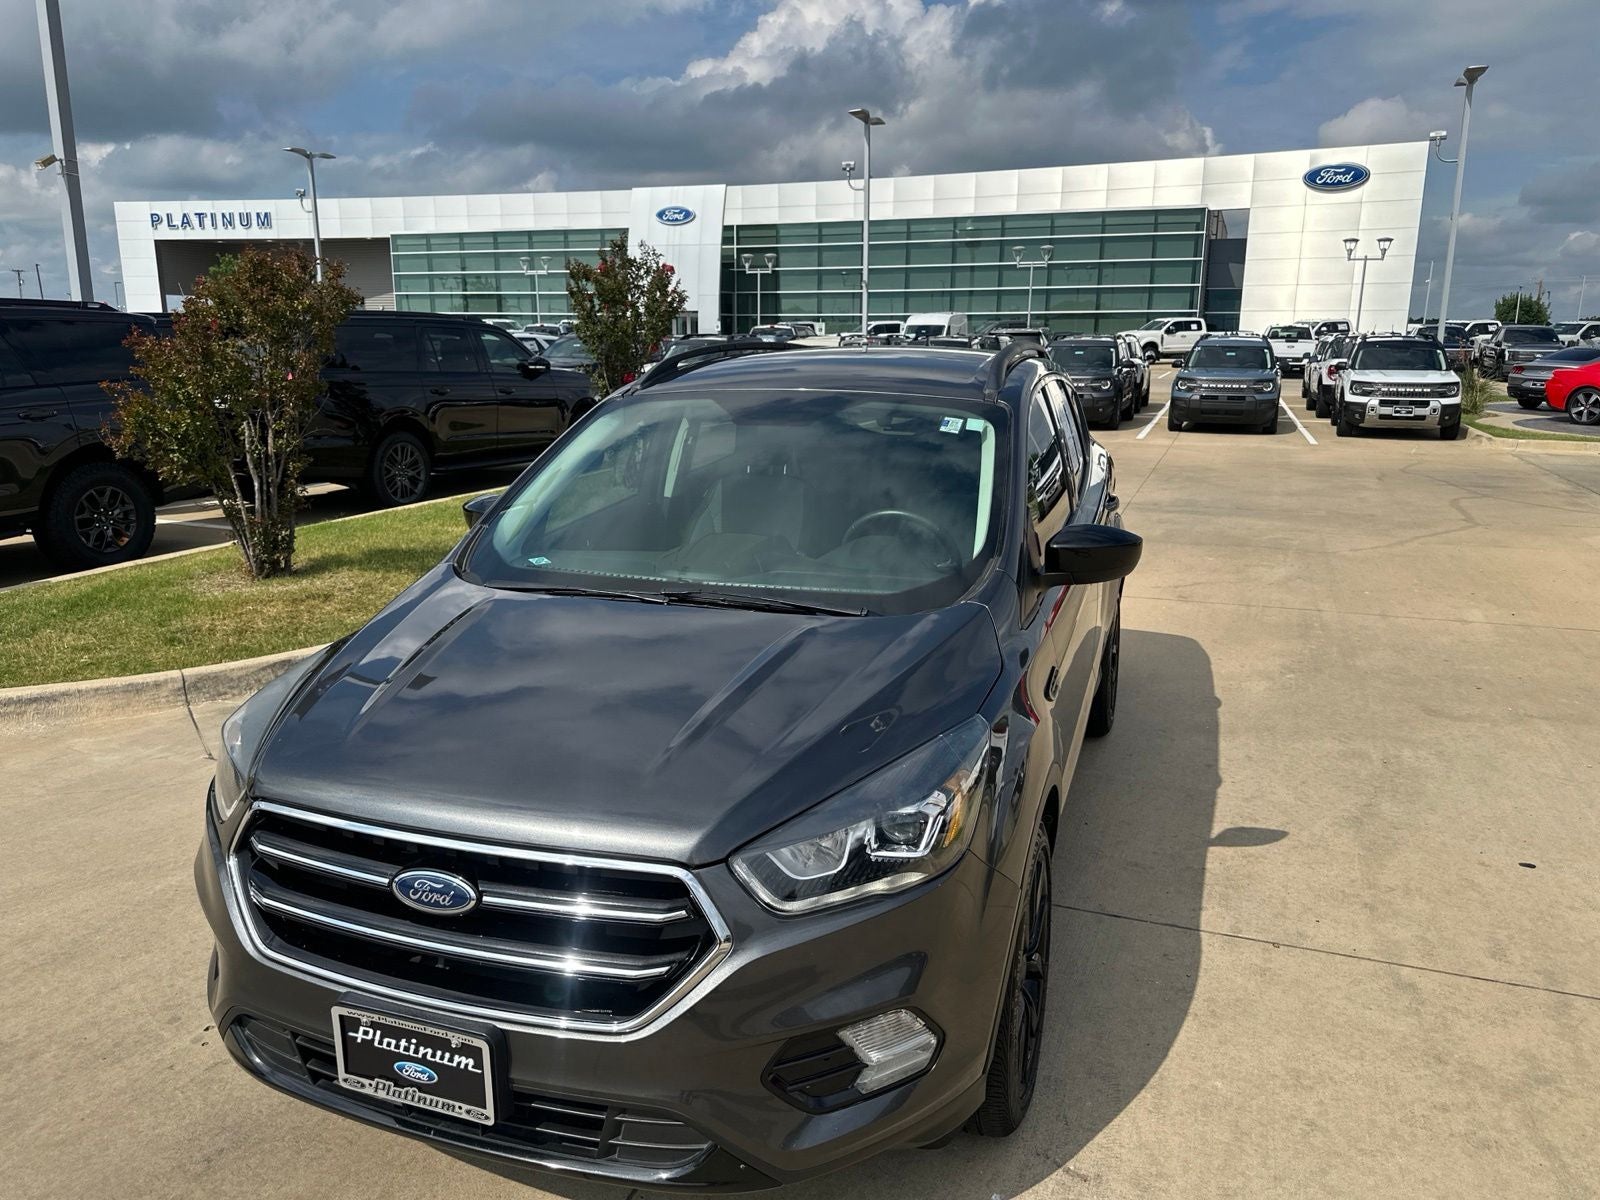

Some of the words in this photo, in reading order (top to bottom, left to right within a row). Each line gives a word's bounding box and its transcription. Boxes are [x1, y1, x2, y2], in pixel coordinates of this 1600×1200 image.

[1316, 168, 1355, 184] Ford
[150, 212, 272, 229] PLATINUM
[662, 209, 686, 220] Ford
[409, 879, 455, 906] Ford
[347, 1026, 483, 1074] Platinum
[402, 1064, 429, 1082] Ford
[373, 1079, 463, 1115] Platinum
